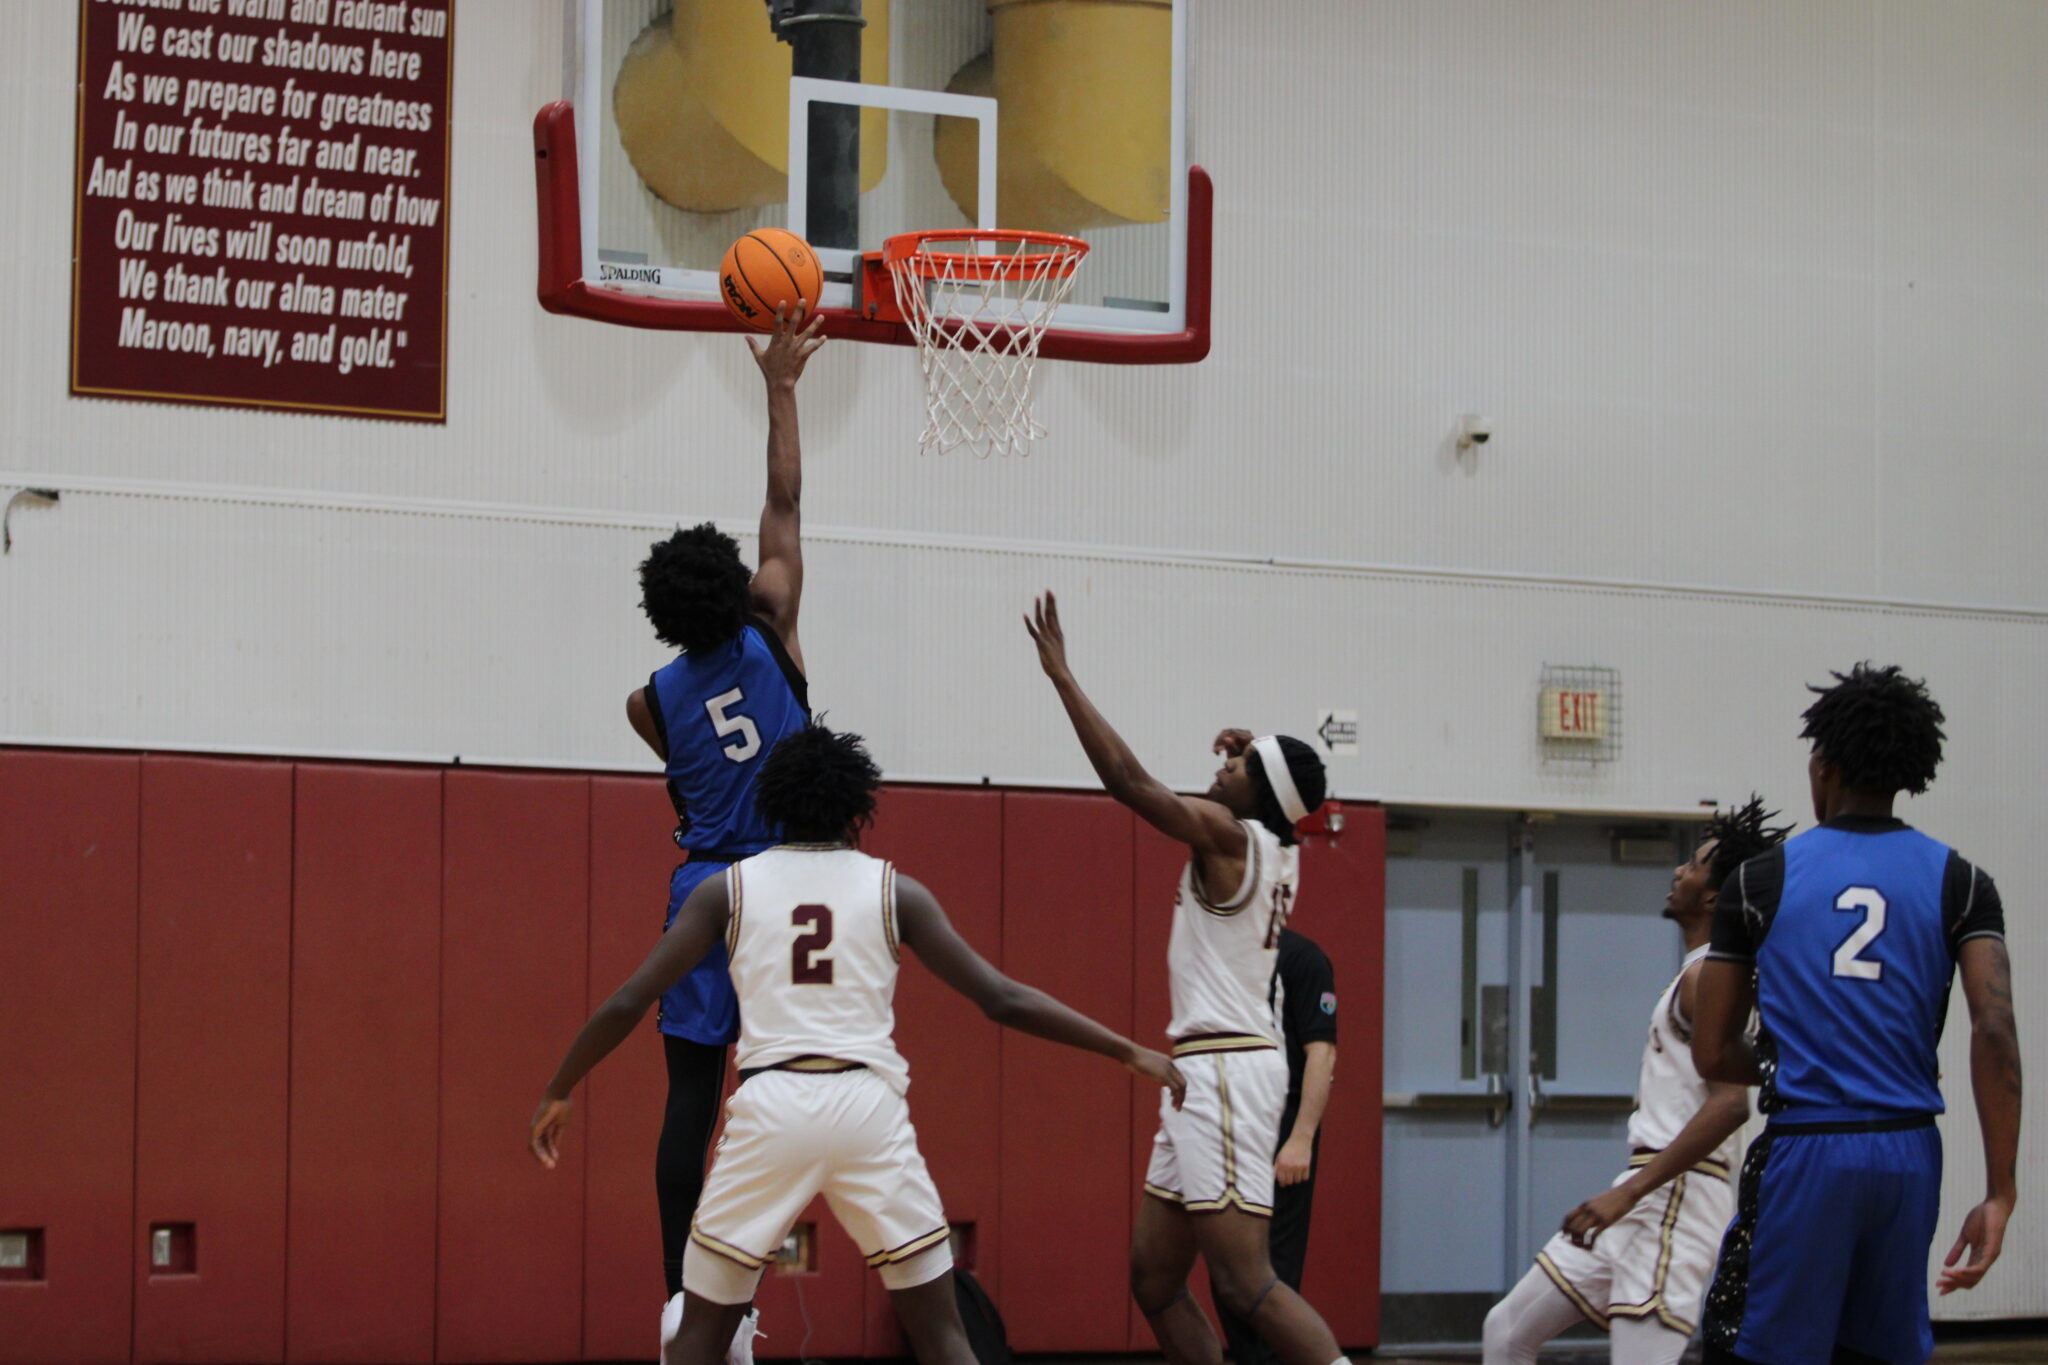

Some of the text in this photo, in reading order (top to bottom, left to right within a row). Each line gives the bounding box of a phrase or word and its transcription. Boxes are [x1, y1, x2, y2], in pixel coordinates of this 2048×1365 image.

[117, 11, 421, 81] We cast our shadows here
[290, 0, 330, 26] and
[333, 0, 407, 34] radiant
[410, 7, 447, 38] sun
[103, 60, 433, 132] As we prepare for greatness
[113, 109, 421, 178] In our futures far and near.
[87, 156, 440, 227] And as we think and dream of how
[115, 208, 415, 279] Our lives will soon unfold,
[599, 264, 662, 285] SPALDING
[118, 257, 408, 321] We thank our alma mater
[118, 306, 408, 375] Maroon, navy, and gold."
[705, 687, 762, 763] 5
[1558, 691, 1598, 732] EXIT
[790, 903, 834, 986] 2
[1831, 885, 1888, 981] 2
